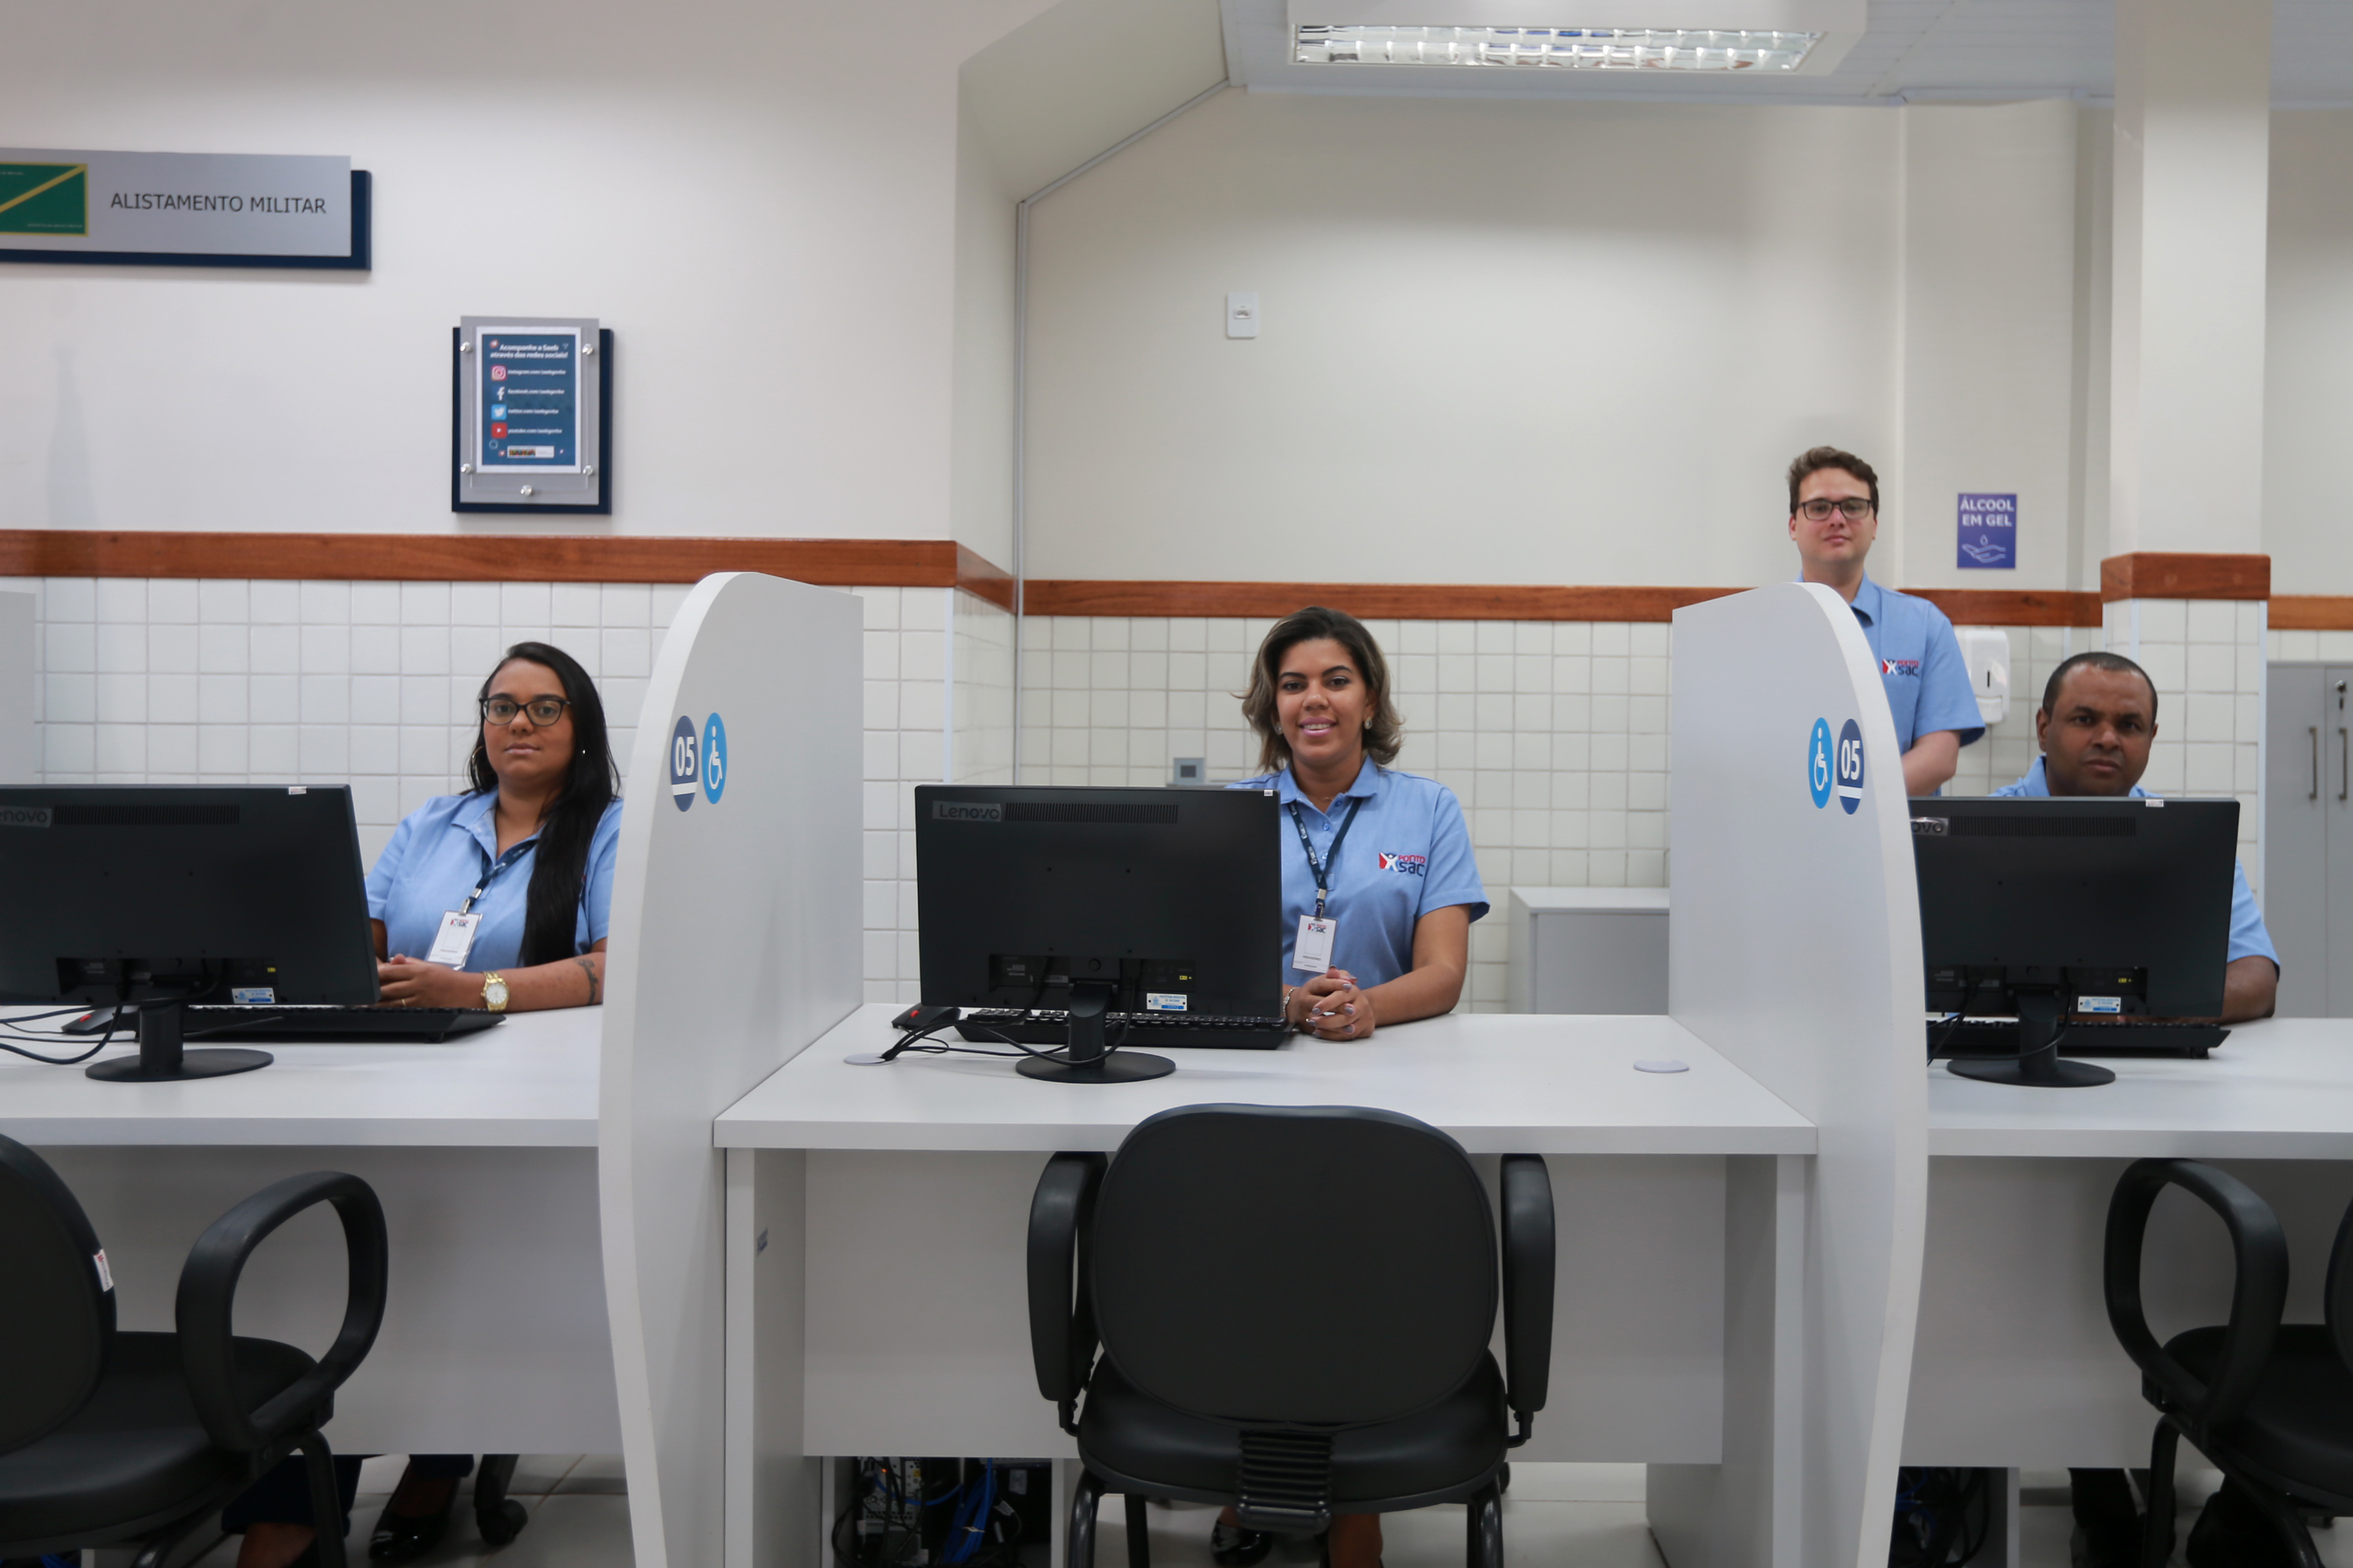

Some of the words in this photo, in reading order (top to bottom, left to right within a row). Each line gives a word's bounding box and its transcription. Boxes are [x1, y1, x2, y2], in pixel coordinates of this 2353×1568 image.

[110, 194, 243, 212] ALISTAMENTO
[250, 197, 327, 214] MILITAR
[1960, 494, 2015, 512] ÁLCOOL
[1962, 513, 1983, 526] EM
[1986, 513, 2013, 526] GEL
[675, 736, 695, 776] 05
[1841, 739, 1861, 780] 05
[0, 810, 48, 823] novo
[939, 804, 1000, 820] Lenovo
